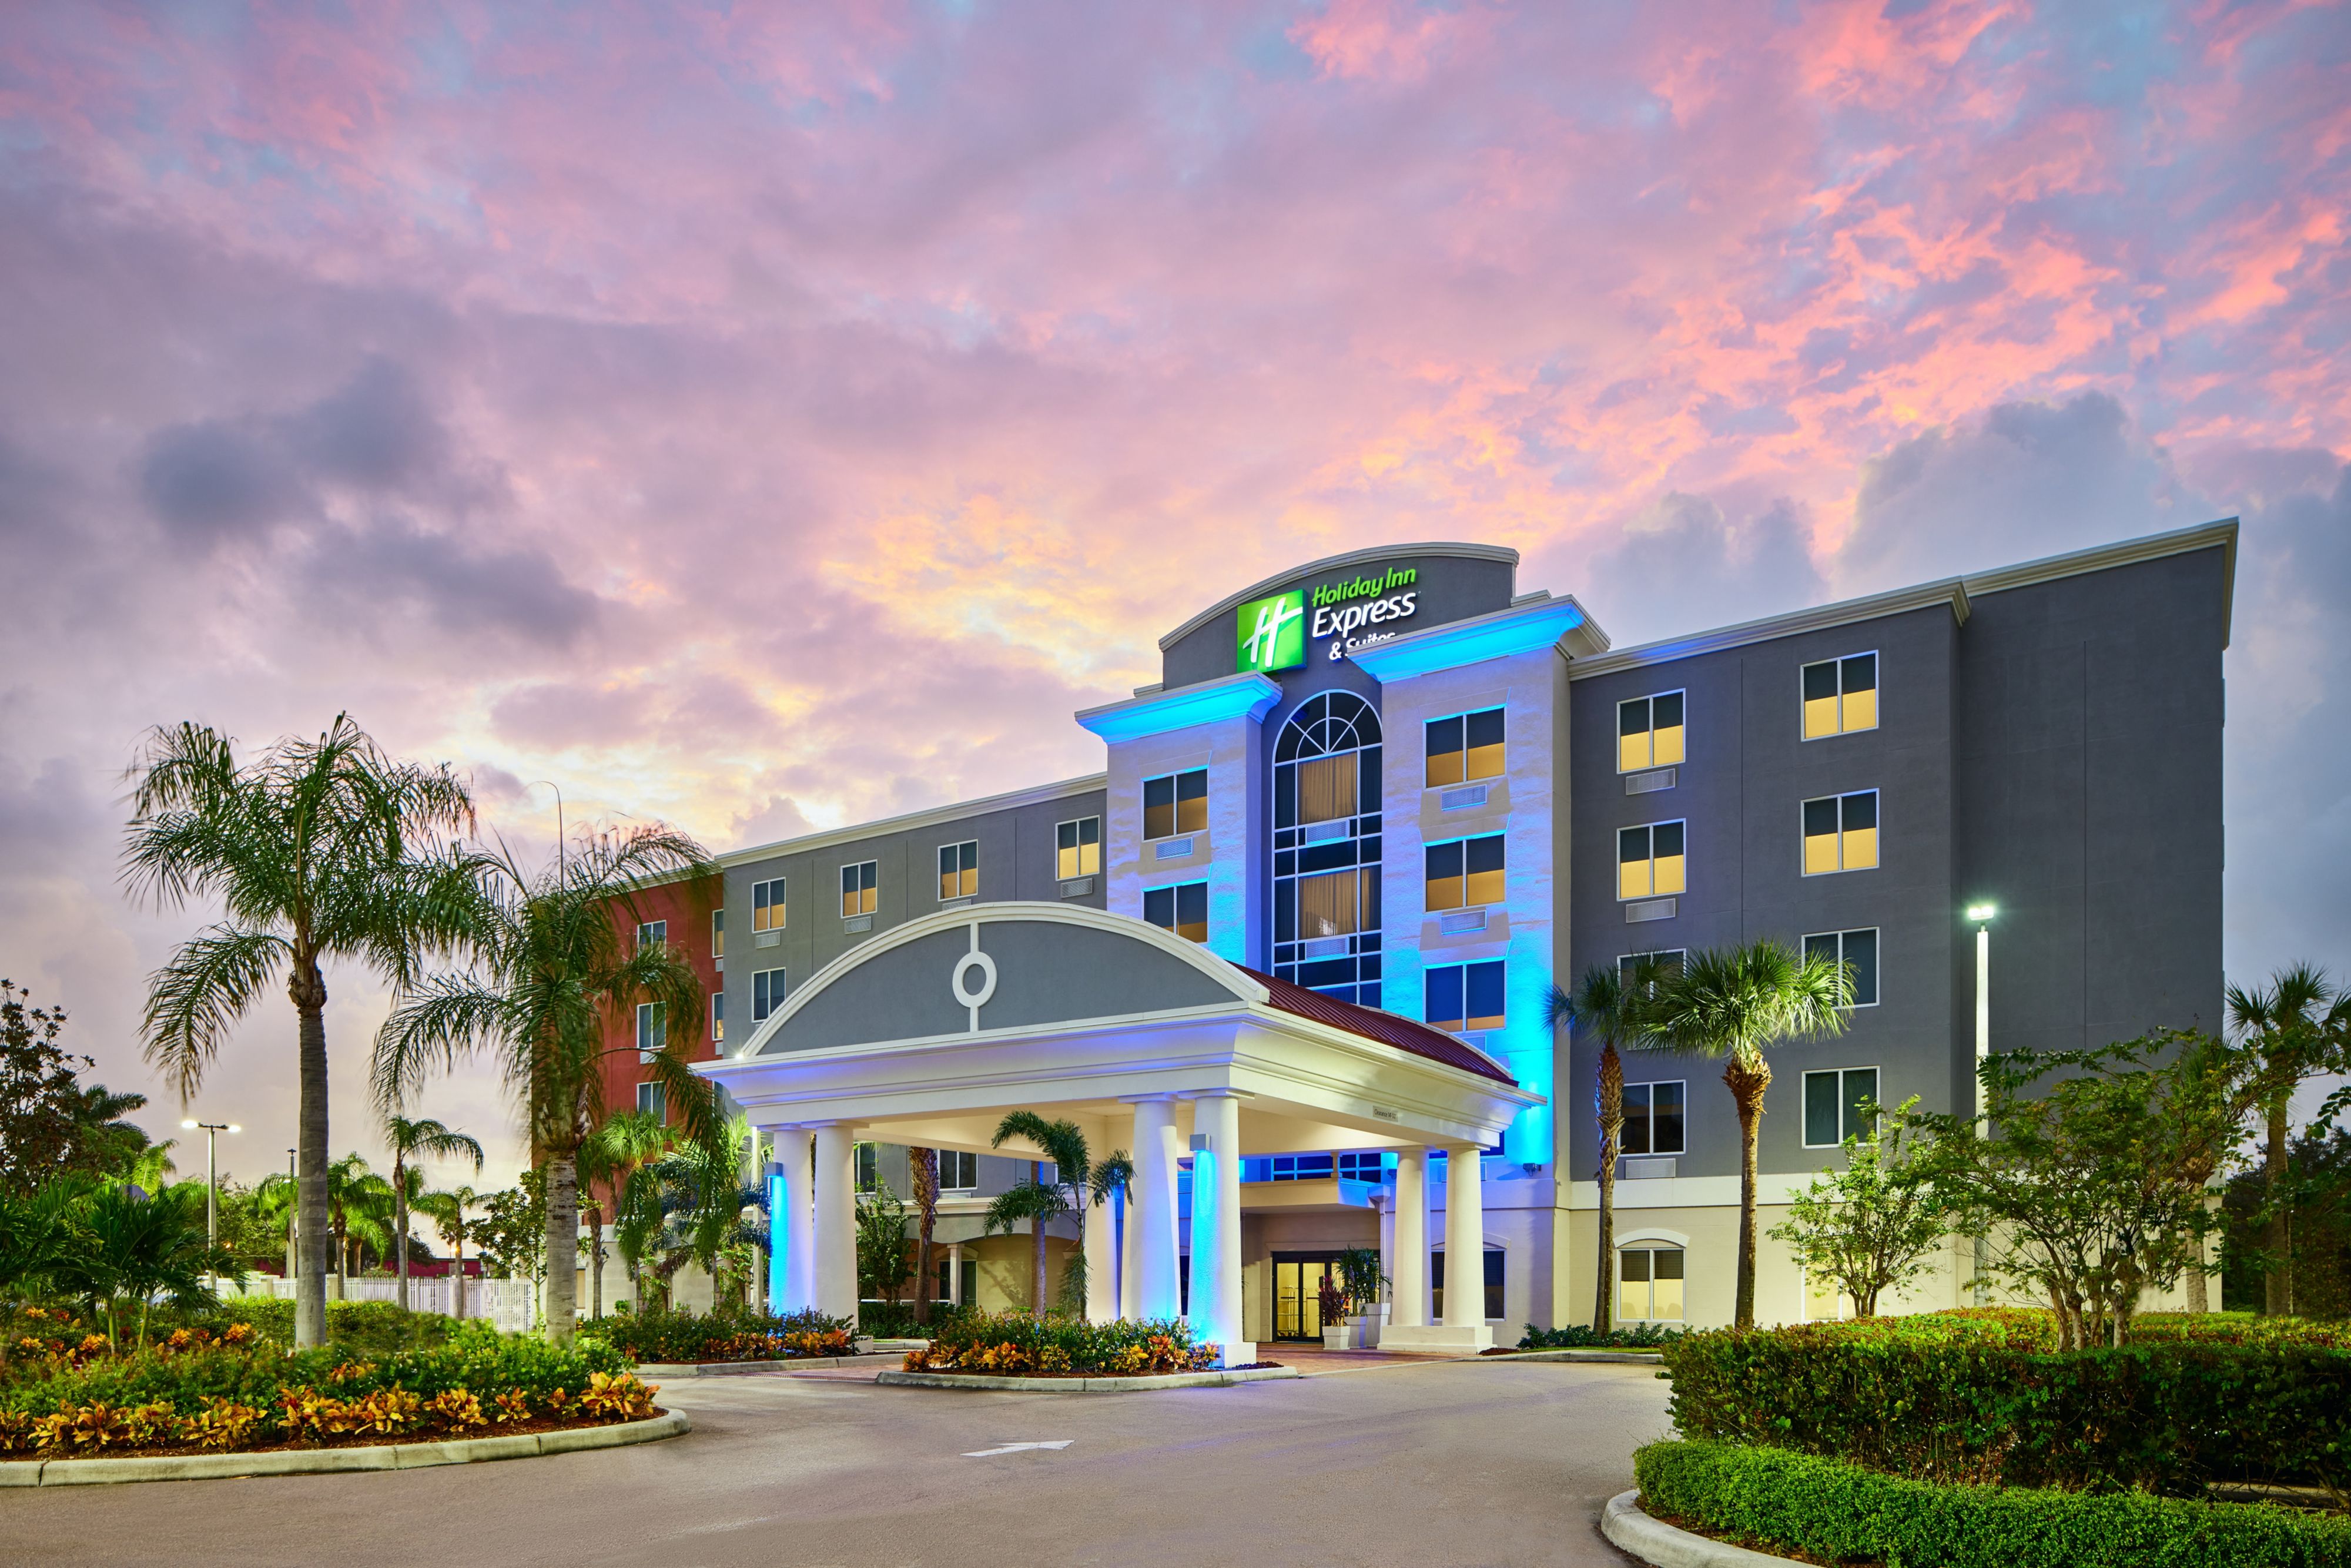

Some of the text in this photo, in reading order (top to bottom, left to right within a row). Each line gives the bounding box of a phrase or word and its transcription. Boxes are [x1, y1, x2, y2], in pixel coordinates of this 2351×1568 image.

[1311, 567, 1416, 607] Holiday Inn
[1312, 592, 1416, 638] Express
[1329, 641, 1342, 661] &
